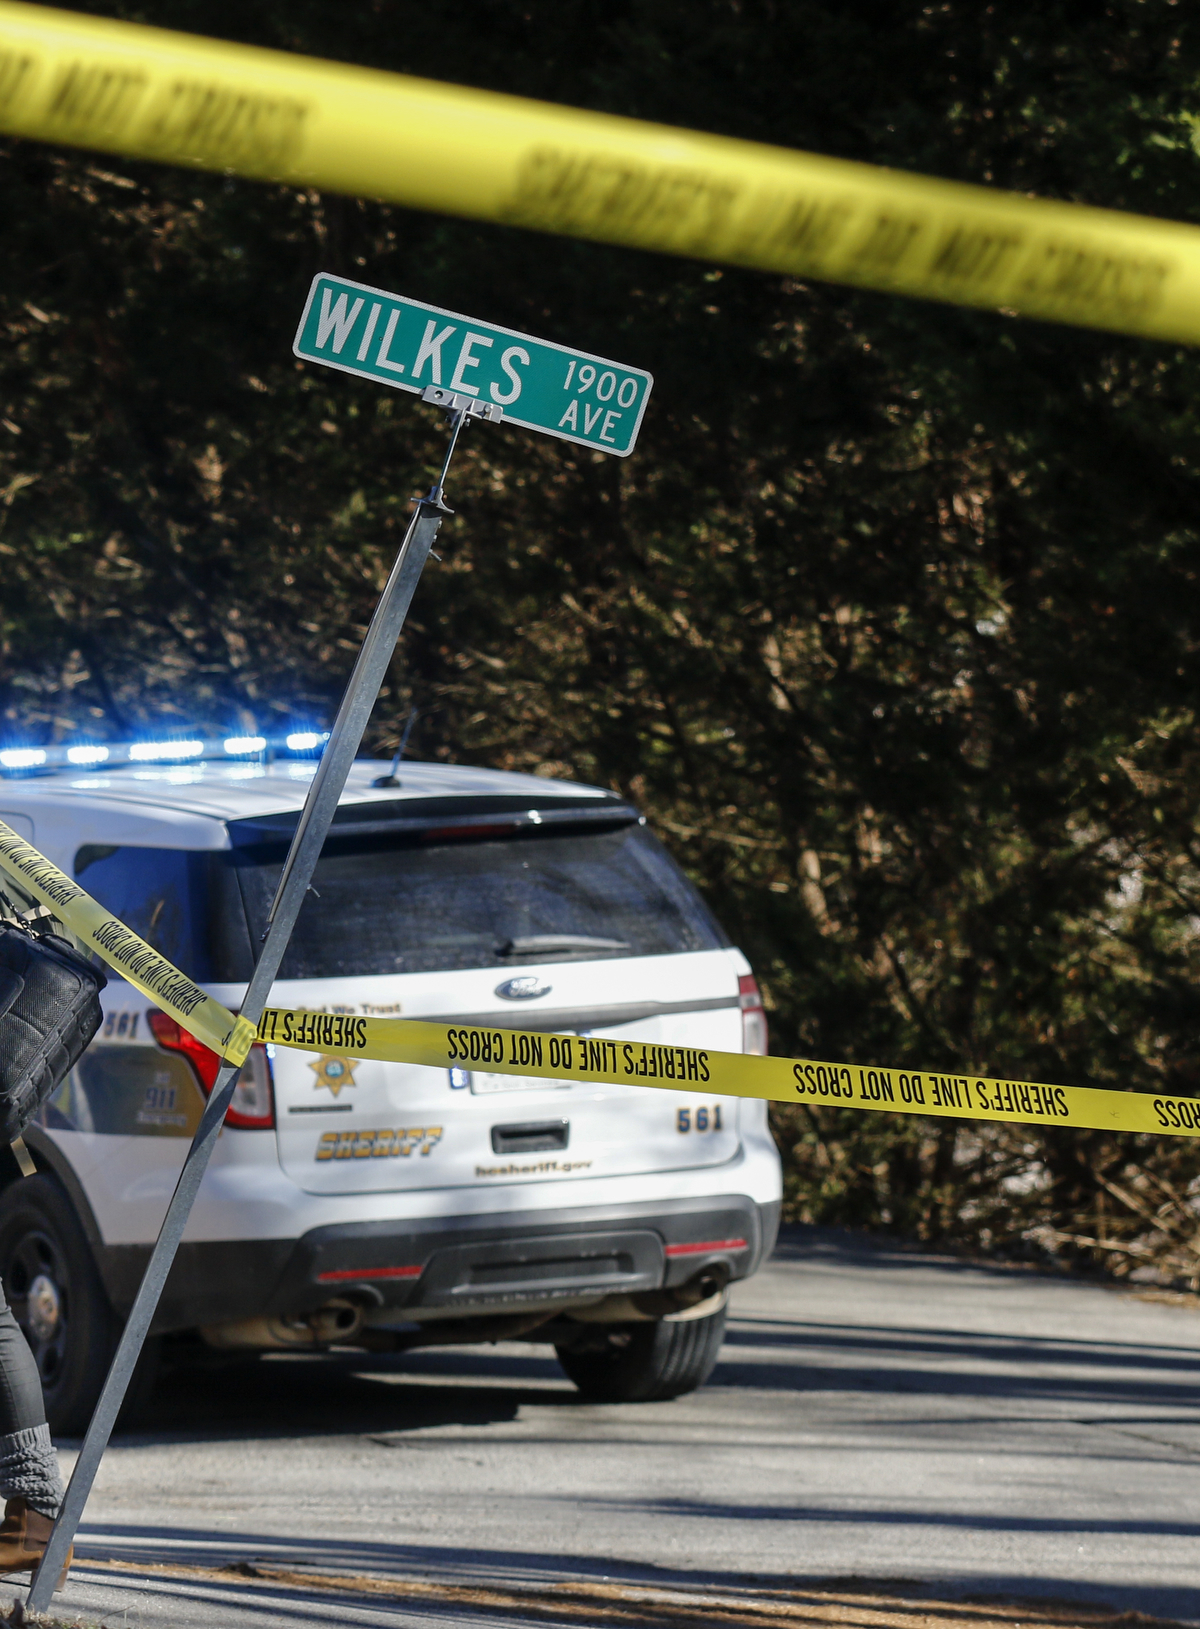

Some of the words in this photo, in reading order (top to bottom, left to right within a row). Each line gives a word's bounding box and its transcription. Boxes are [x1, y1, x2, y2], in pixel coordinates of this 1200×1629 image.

[314, 287, 531, 406] WILKES
[563, 360, 638, 409] 1900
[558, 399, 622, 443] AVE
[9, 849, 40, 864] DO
[18, 858, 54, 878] LINE
[34, 871, 86, 907] SHERIFF'S
[92, 921, 132, 952] CROSS
[114, 940, 147, 965] NOT
[130, 952, 157, 974] DO
[140, 960, 174, 988] LINE
[157, 973, 208, 1017] SHERIFF'S
[104, 1011, 140, 1039] 561
[257, 1011, 279, 1040] LI
[282, 1012, 367, 1049] SHERIFF'S
[447, 1028, 504, 1063] CROSS
[509, 1034, 542, 1067] NOT
[550, 1037, 572, 1069] DO
[578, 1040, 617, 1073] LINE
[623, 1044, 710, 1083] SHERIFF'S
[793, 1063, 853, 1098] CROSS
[860, 1070, 895, 1102] NOT
[899, 1074, 926, 1105] DO
[929, 1076, 973, 1109] LINE
[145, 1086, 177, 1109] 911
[976, 1081, 1069, 1117] SHERIFF'S
[676, 1105, 723, 1134] 561
[1153, 1099, 1200, 1129] ROSS
[315, 1127, 443, 1162] SHERIFF
